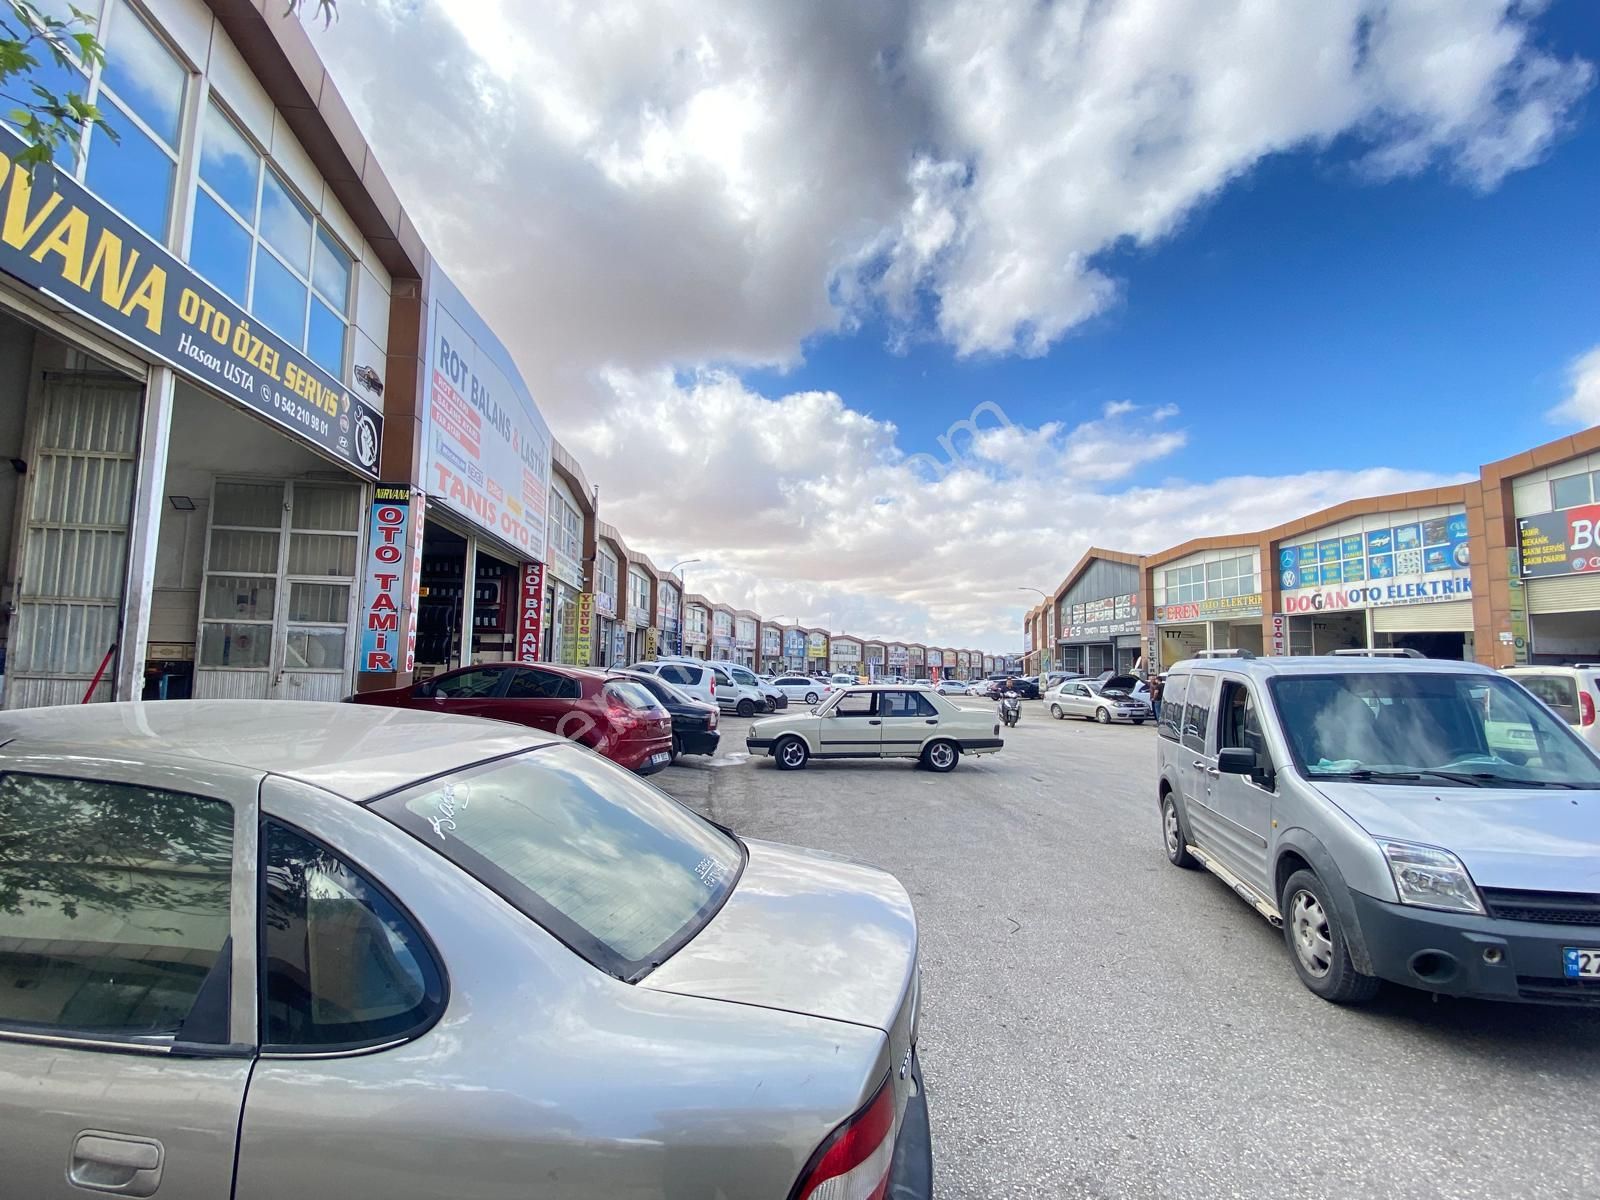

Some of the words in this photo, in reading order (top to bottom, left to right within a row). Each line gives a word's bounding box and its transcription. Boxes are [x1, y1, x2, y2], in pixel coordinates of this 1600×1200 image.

[178, 287, 231, 346] OTO
[232, 320, 281, 382] ÖZEL
[177, 333, 222, 373] Hasan
[223, 360, 255, 393] USTA
[440, 336, 468, 393] ROT
[470, 374, 511, 443] BALANS
[274, 391, 280, 408] 0
[281, 396, 296, 415] 542
[296, 408, 310, 426] 210
[310, 414, 320, 431] 98
[320, 420, 328, 437] 01
[375, 506, 404, 564] OTO
[500, 511, 529, 546] OTO
[525, 564, 540, 595] ROT
[1349, 586, 1382, 604] OTO
[522, 598, 538, 662] BALANS
[579, 594, 590, 635] YUNUS
[1167, 602, 1200, 619] EREN
